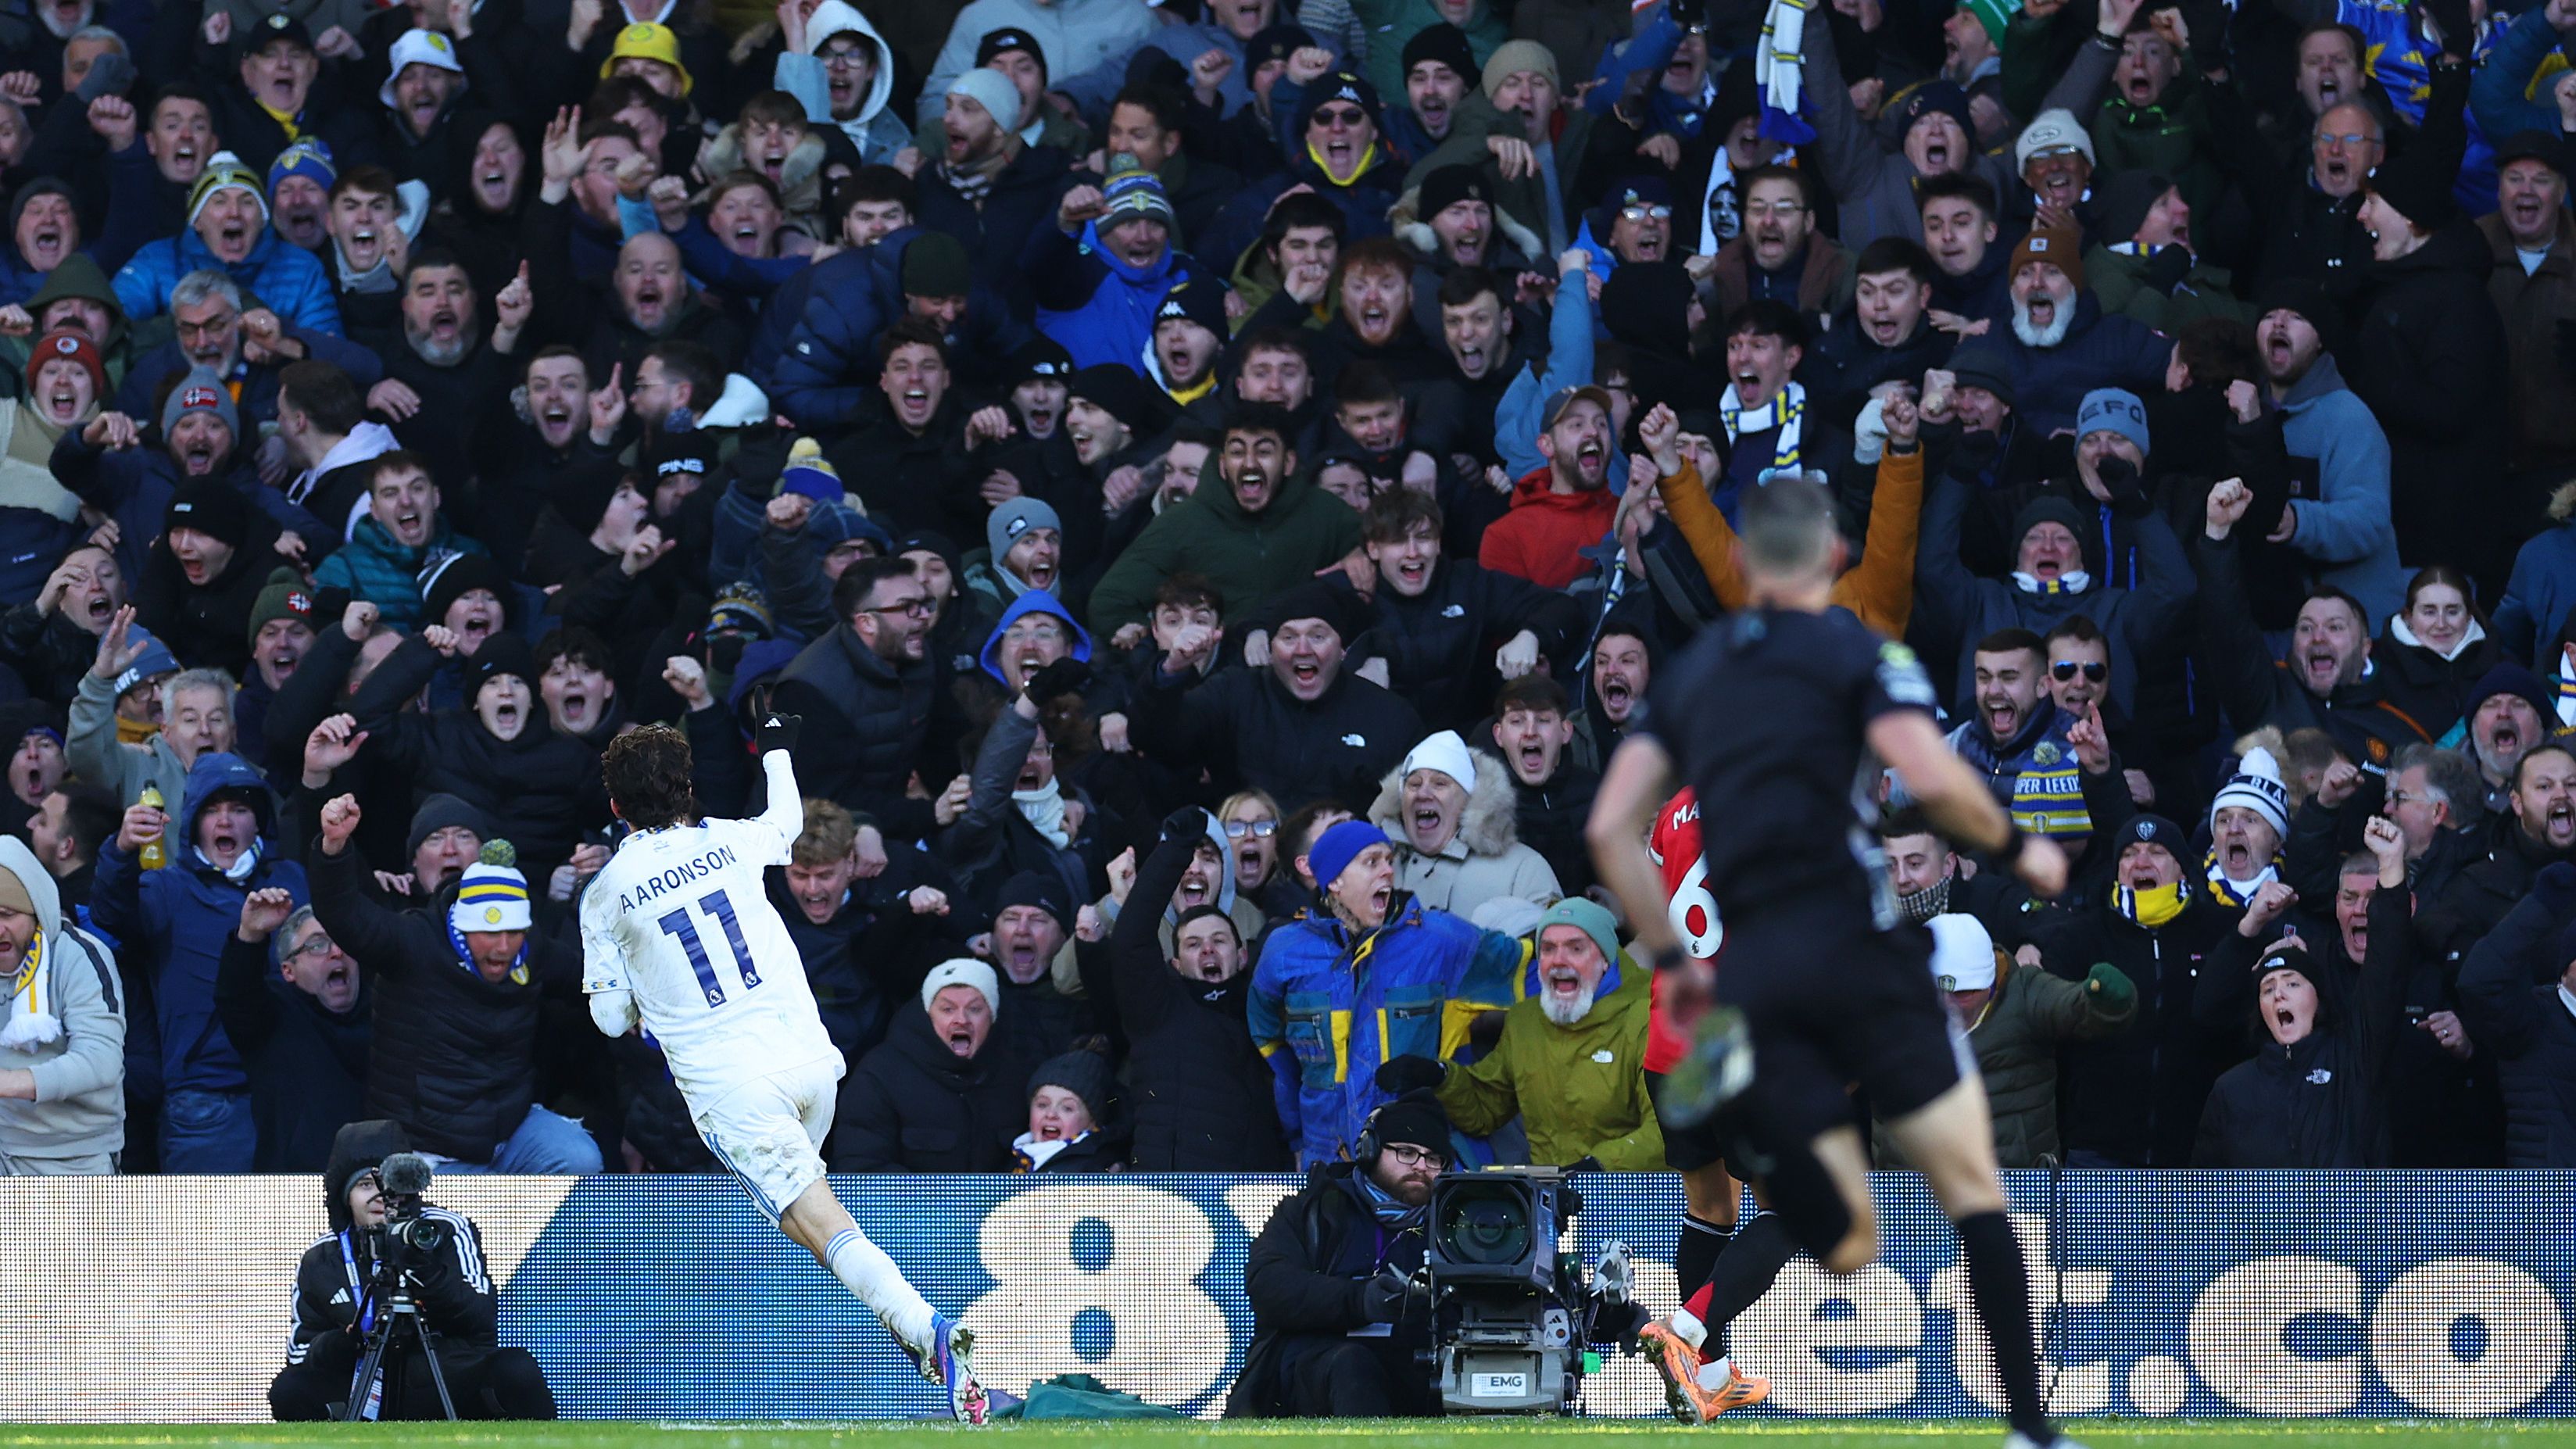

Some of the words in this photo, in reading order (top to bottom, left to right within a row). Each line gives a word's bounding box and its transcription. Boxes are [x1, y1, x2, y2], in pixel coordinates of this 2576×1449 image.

[658, 458, 704, 476] PING
[620, 845, 736, 914] AARONSON
[1668, 849, 1724, 959] 6
[657, 888, 763, 1008] 11
[1490, 1376, 1522, 1387] EMG
